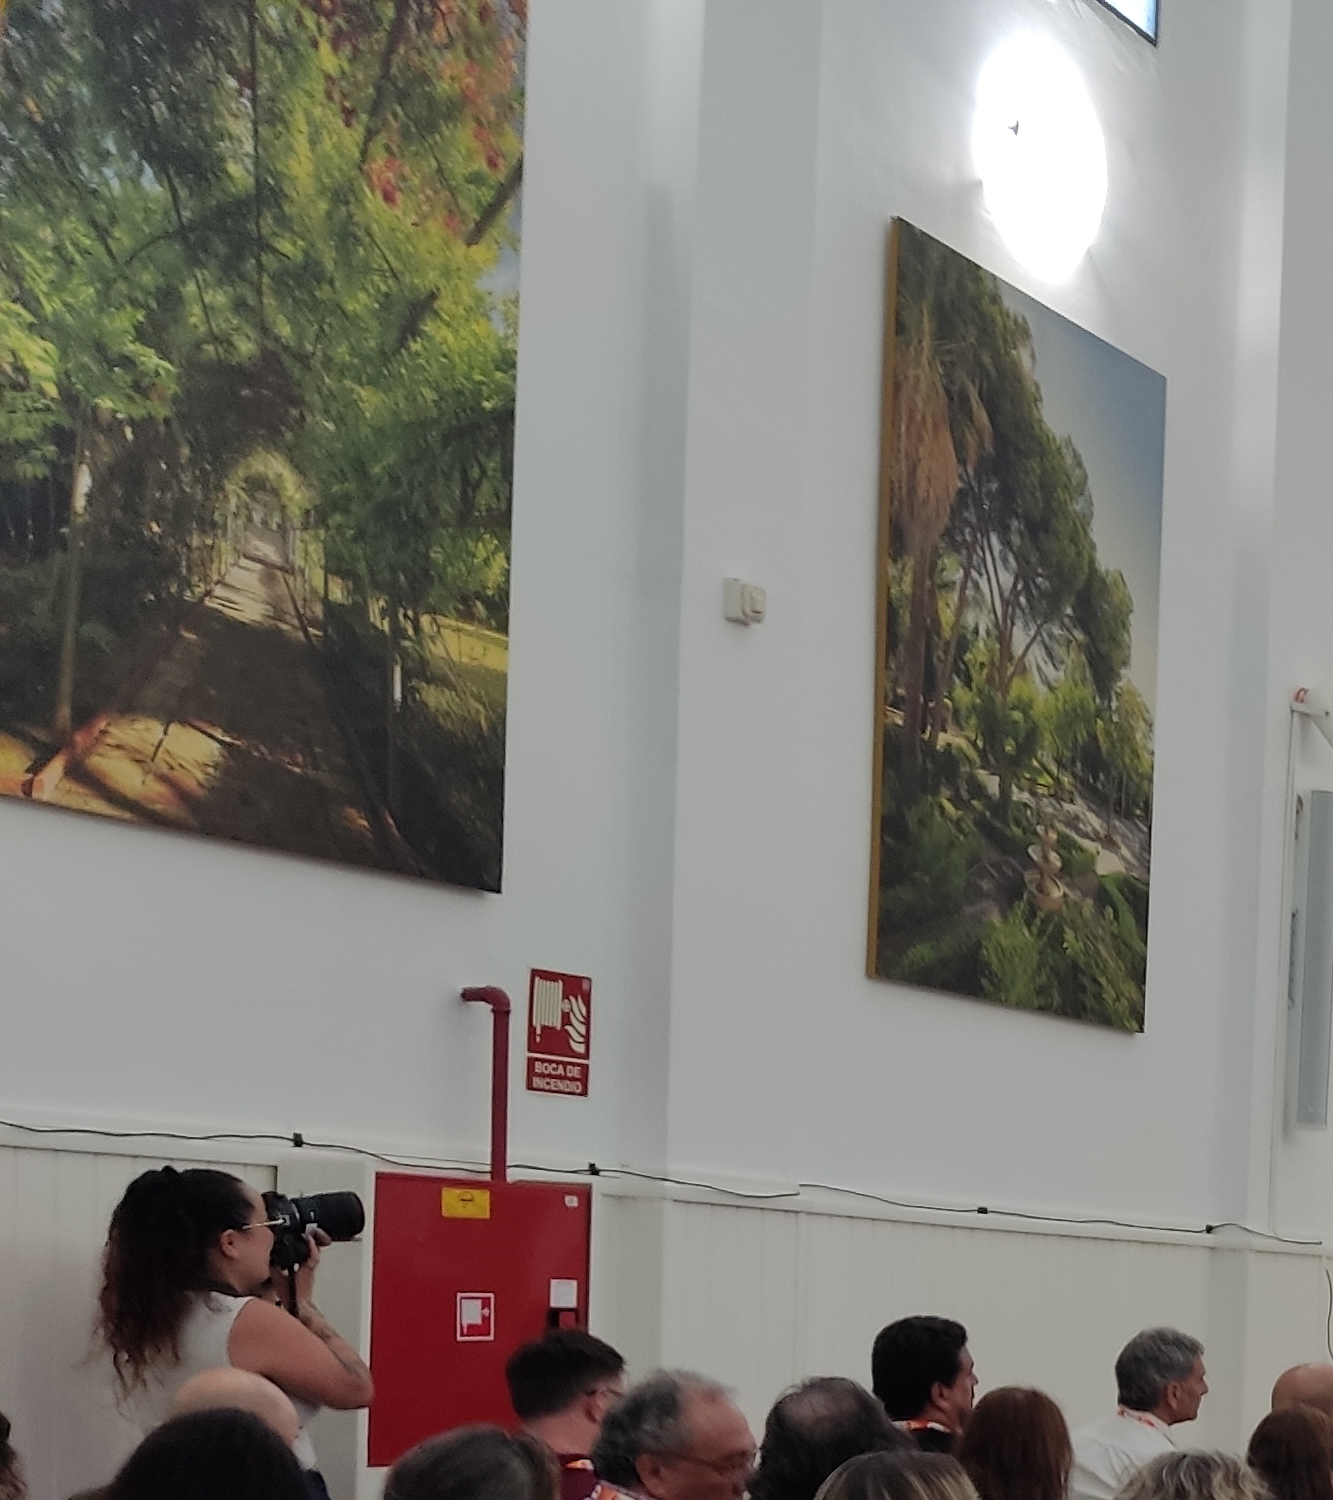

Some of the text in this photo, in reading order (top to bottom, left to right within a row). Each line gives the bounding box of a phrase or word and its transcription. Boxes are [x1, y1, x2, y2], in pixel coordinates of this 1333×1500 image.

[534, 1061, 582, 1078] BOCA DE
[532, 1076, 582, 1093] INCENDIO
